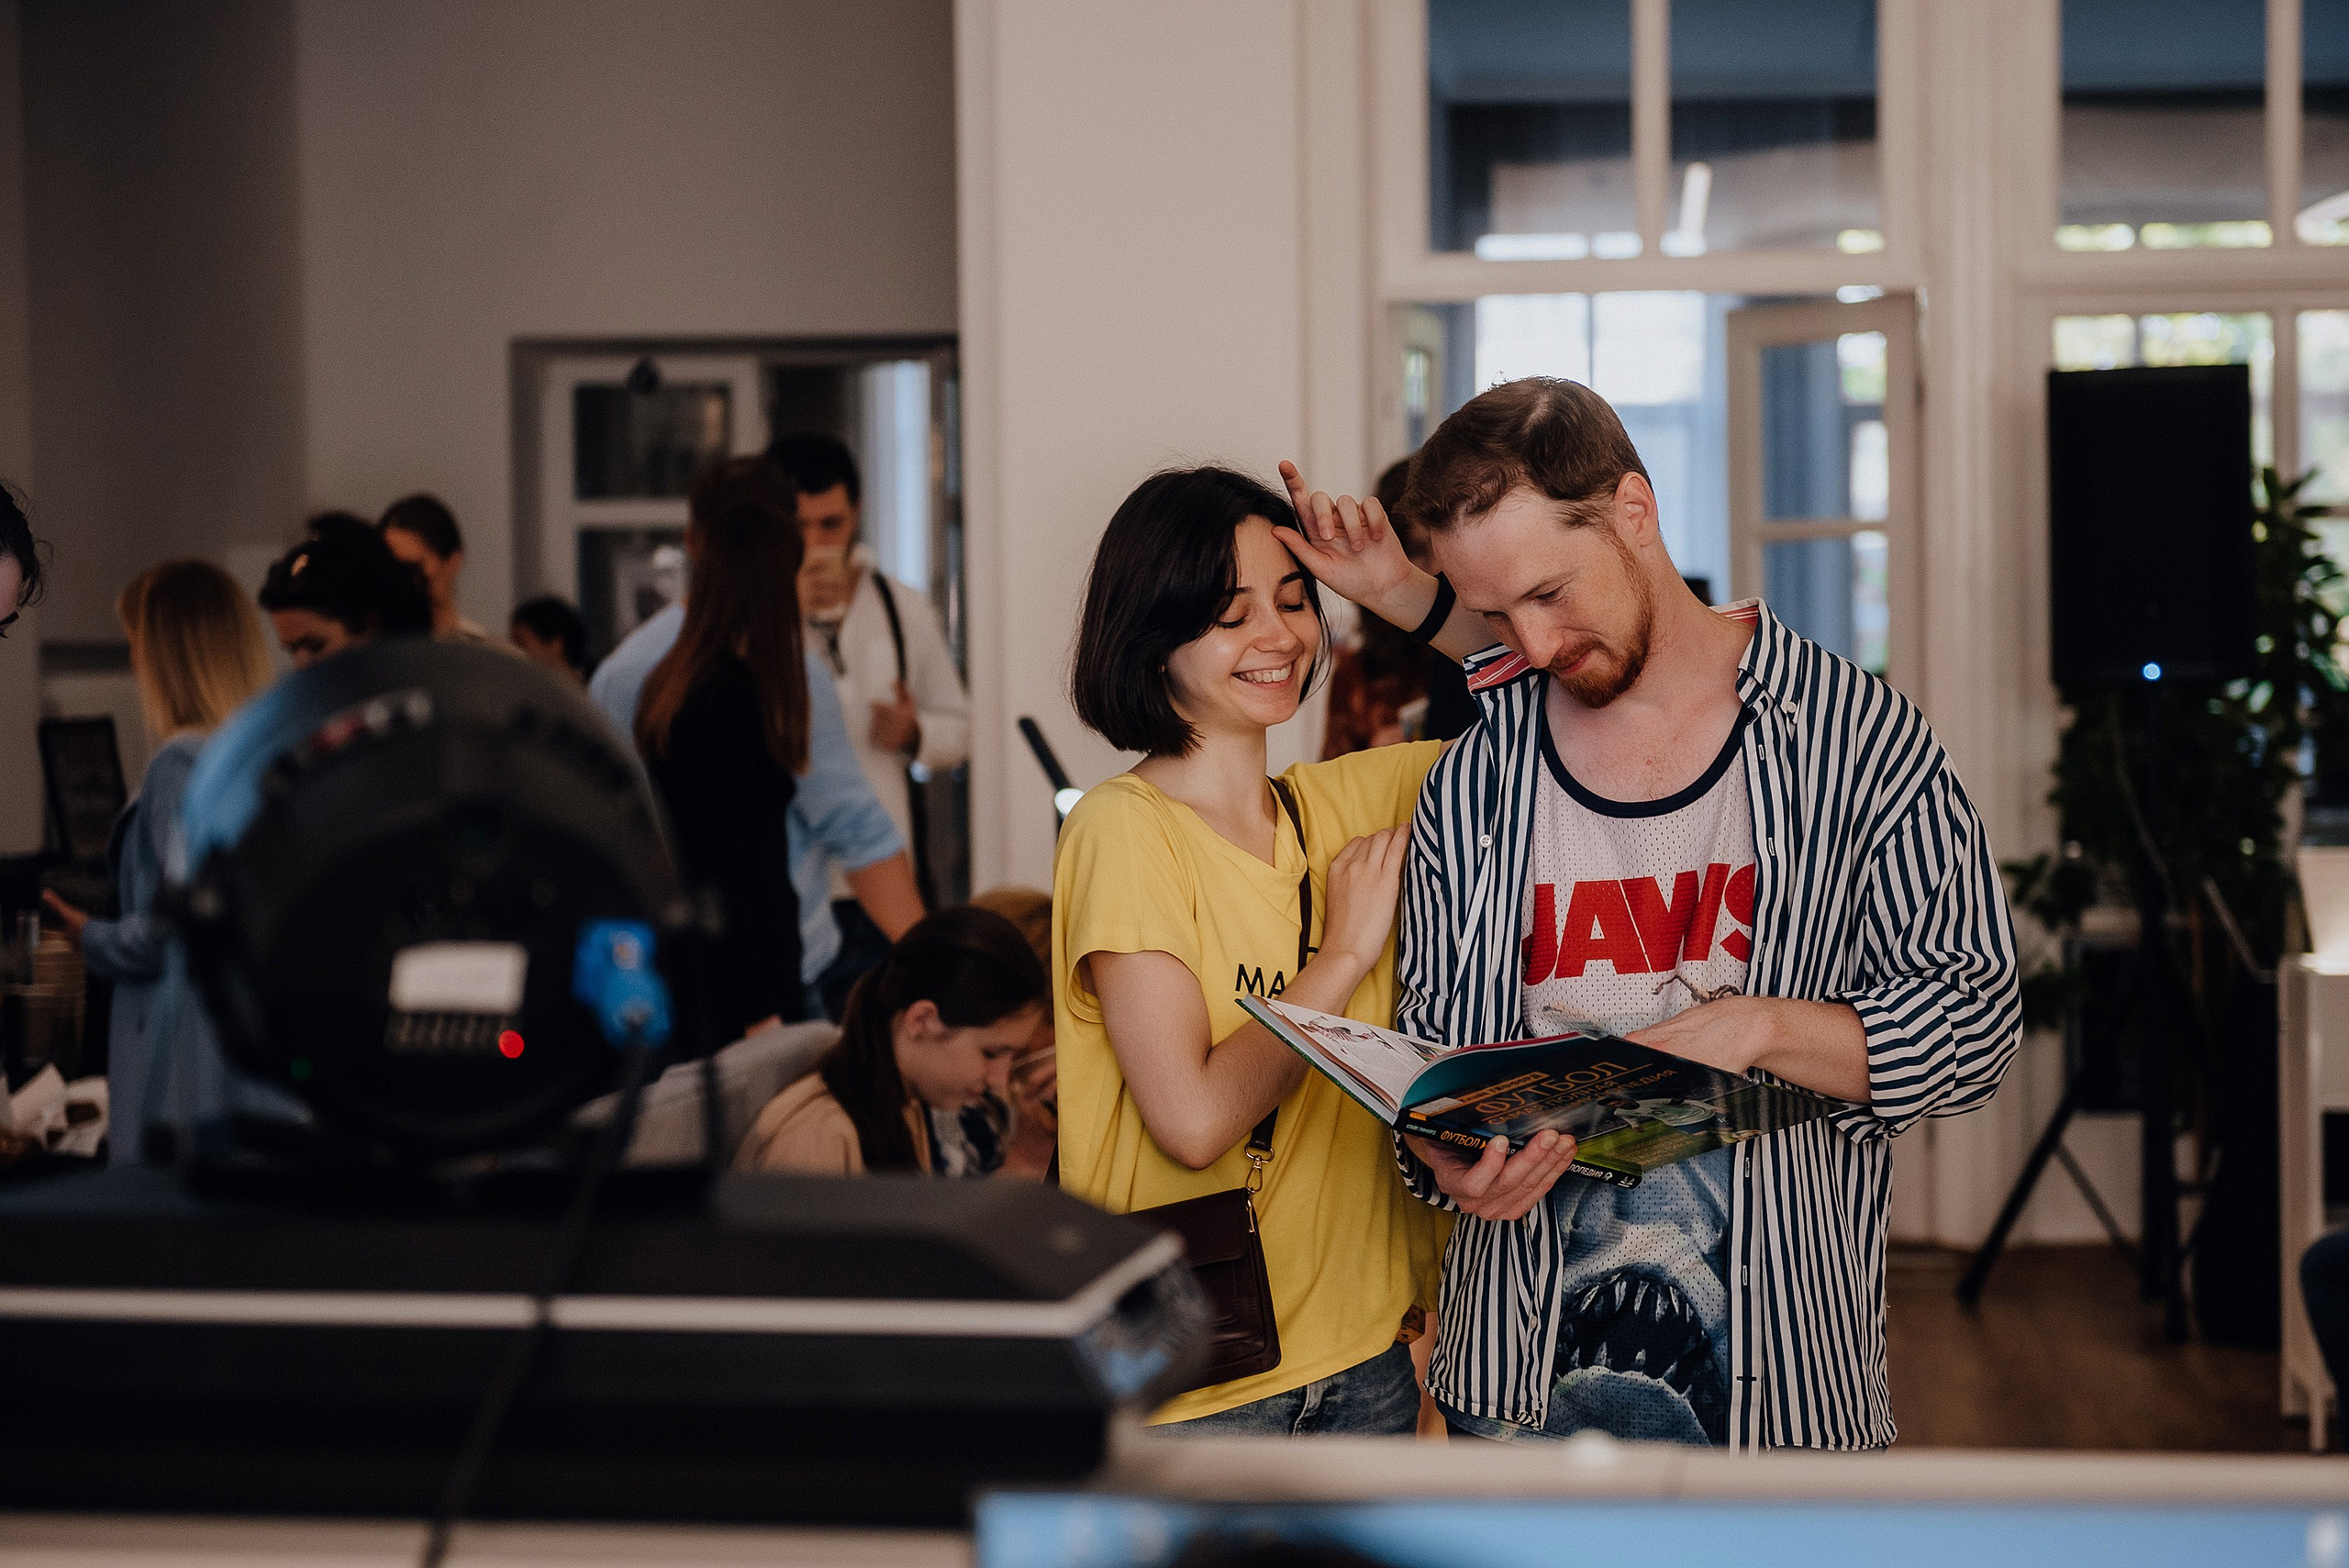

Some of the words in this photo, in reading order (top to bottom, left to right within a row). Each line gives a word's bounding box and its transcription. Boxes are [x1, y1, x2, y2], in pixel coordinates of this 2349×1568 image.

[1521, 862, 1755, 986] JAWS
[1235, 963, 1286, 998] MA
[1475, 1061, 1629, 1114] ФУТБОЛ
[1543, 1080, 1620, 1106] ПОЛНАЯ
[1440, 1129, 1481, 1149] ФУТБОЛ
[1567, 1163, 1603, 1179] ЛОПЕДИЯ
